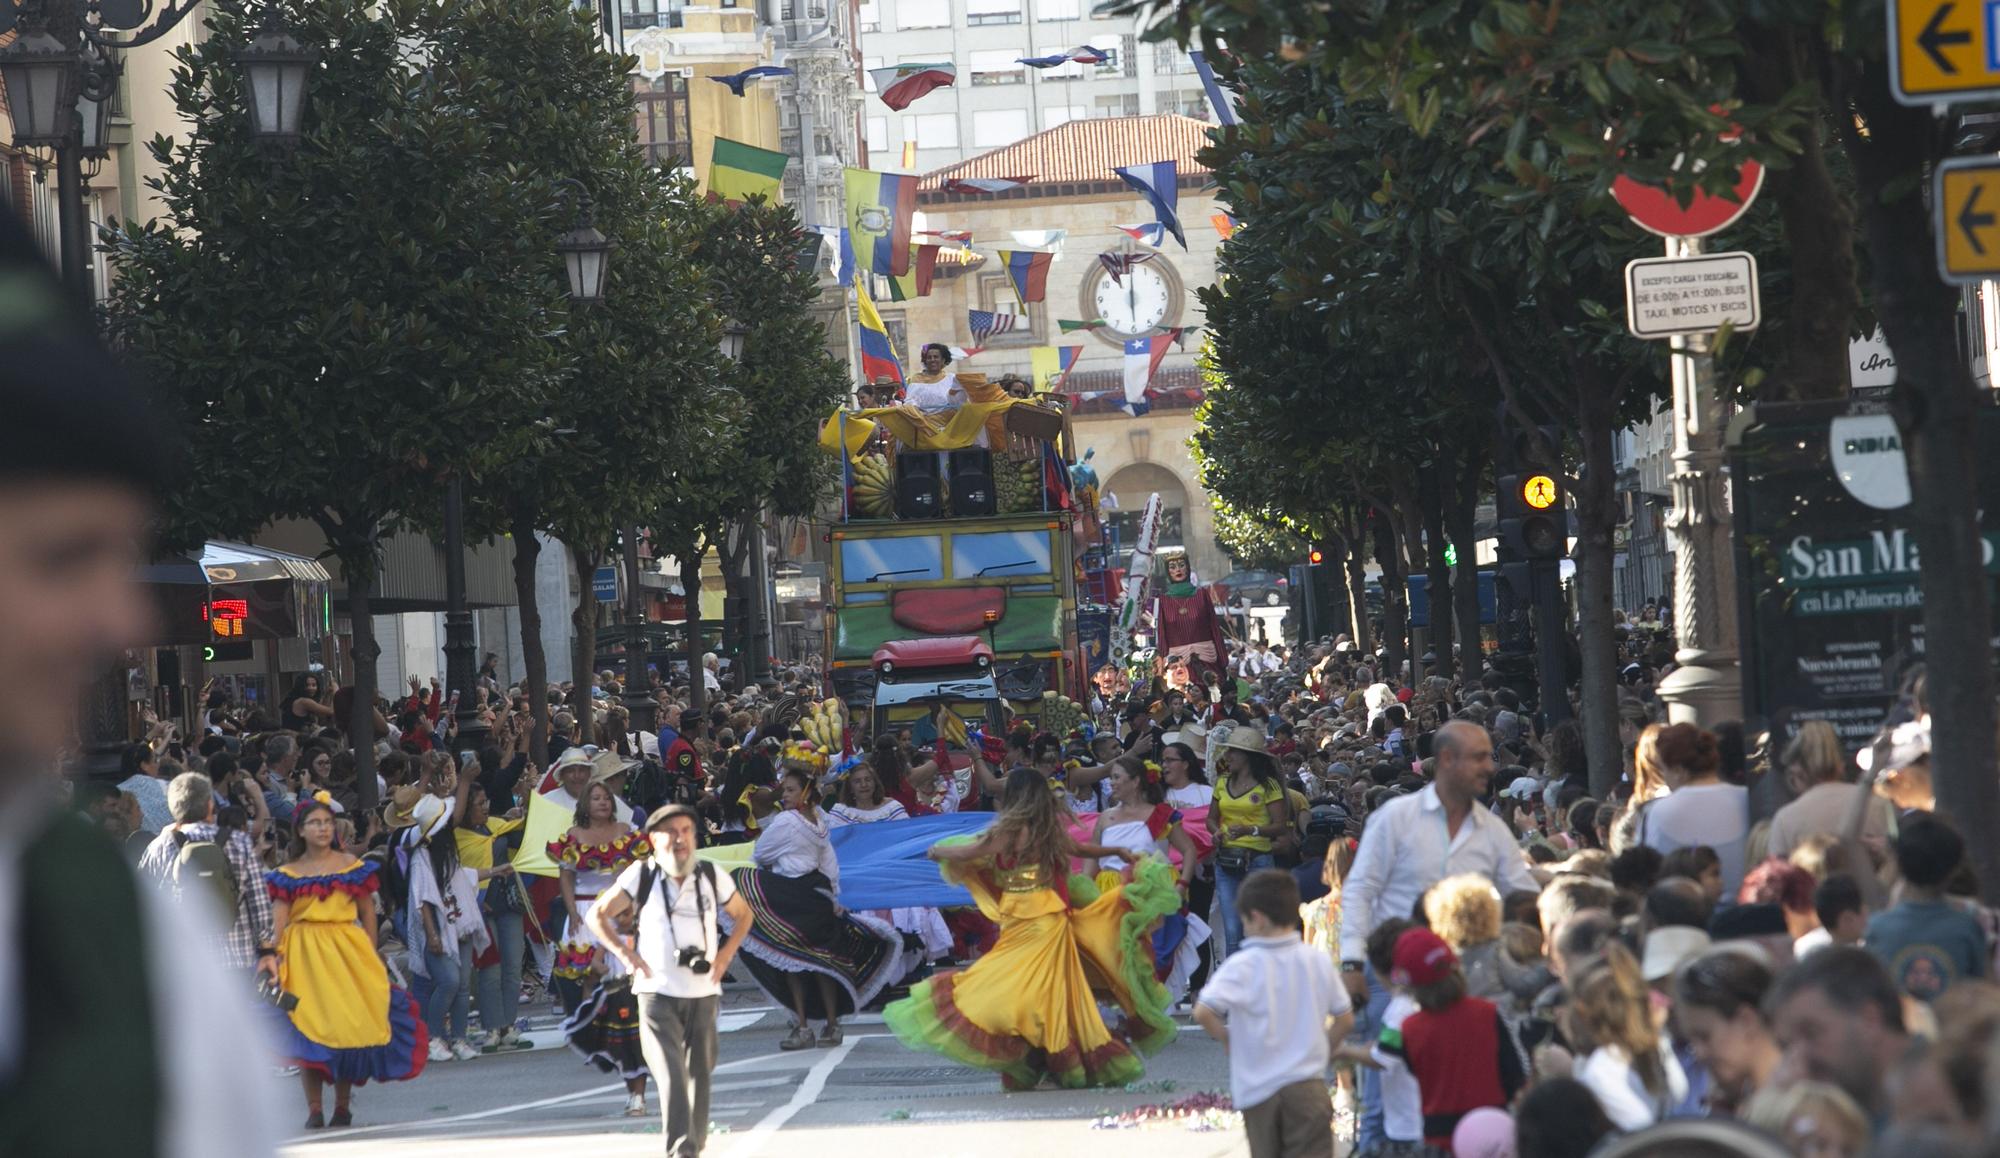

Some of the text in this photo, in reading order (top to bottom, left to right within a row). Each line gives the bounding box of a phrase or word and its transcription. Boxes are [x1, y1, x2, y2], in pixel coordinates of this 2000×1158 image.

[1143, 267, 1147, 275] 1
[1155, 276, 1160, 285] 2
[1642, 272, 1738, 286] EXCEPTO CARGA Y DESCARGA
[1102, 281, 1110, 289] 10
[1161, 291, 1167, 301] 3
[1637, 294, 1650, 304] DE
[1682, 290, 1689, 299] A
[1725, 285, 1746, 295] BUS
[1156, 308, 1163, 316] 4
[1672, 303, 1708, 315] MOTOS
[1711, 303, 1718, 312] Y
[1720, 301, 1747, 312] BICIS
[1102, 310, 1109, 318] 8
[1147, 319, 1153, 328] 5
[1131, 325, 1137, 333] 6
[1860, 353, 1897, 371] An
[1845, 436, 1901, 455] INDIA
[1787, 535, 1864, 580] San
[1801, 596, 1821, 613] en
[1822, 590, 1842, 611] La
[1844, 588, 1903, 610] Palmera
